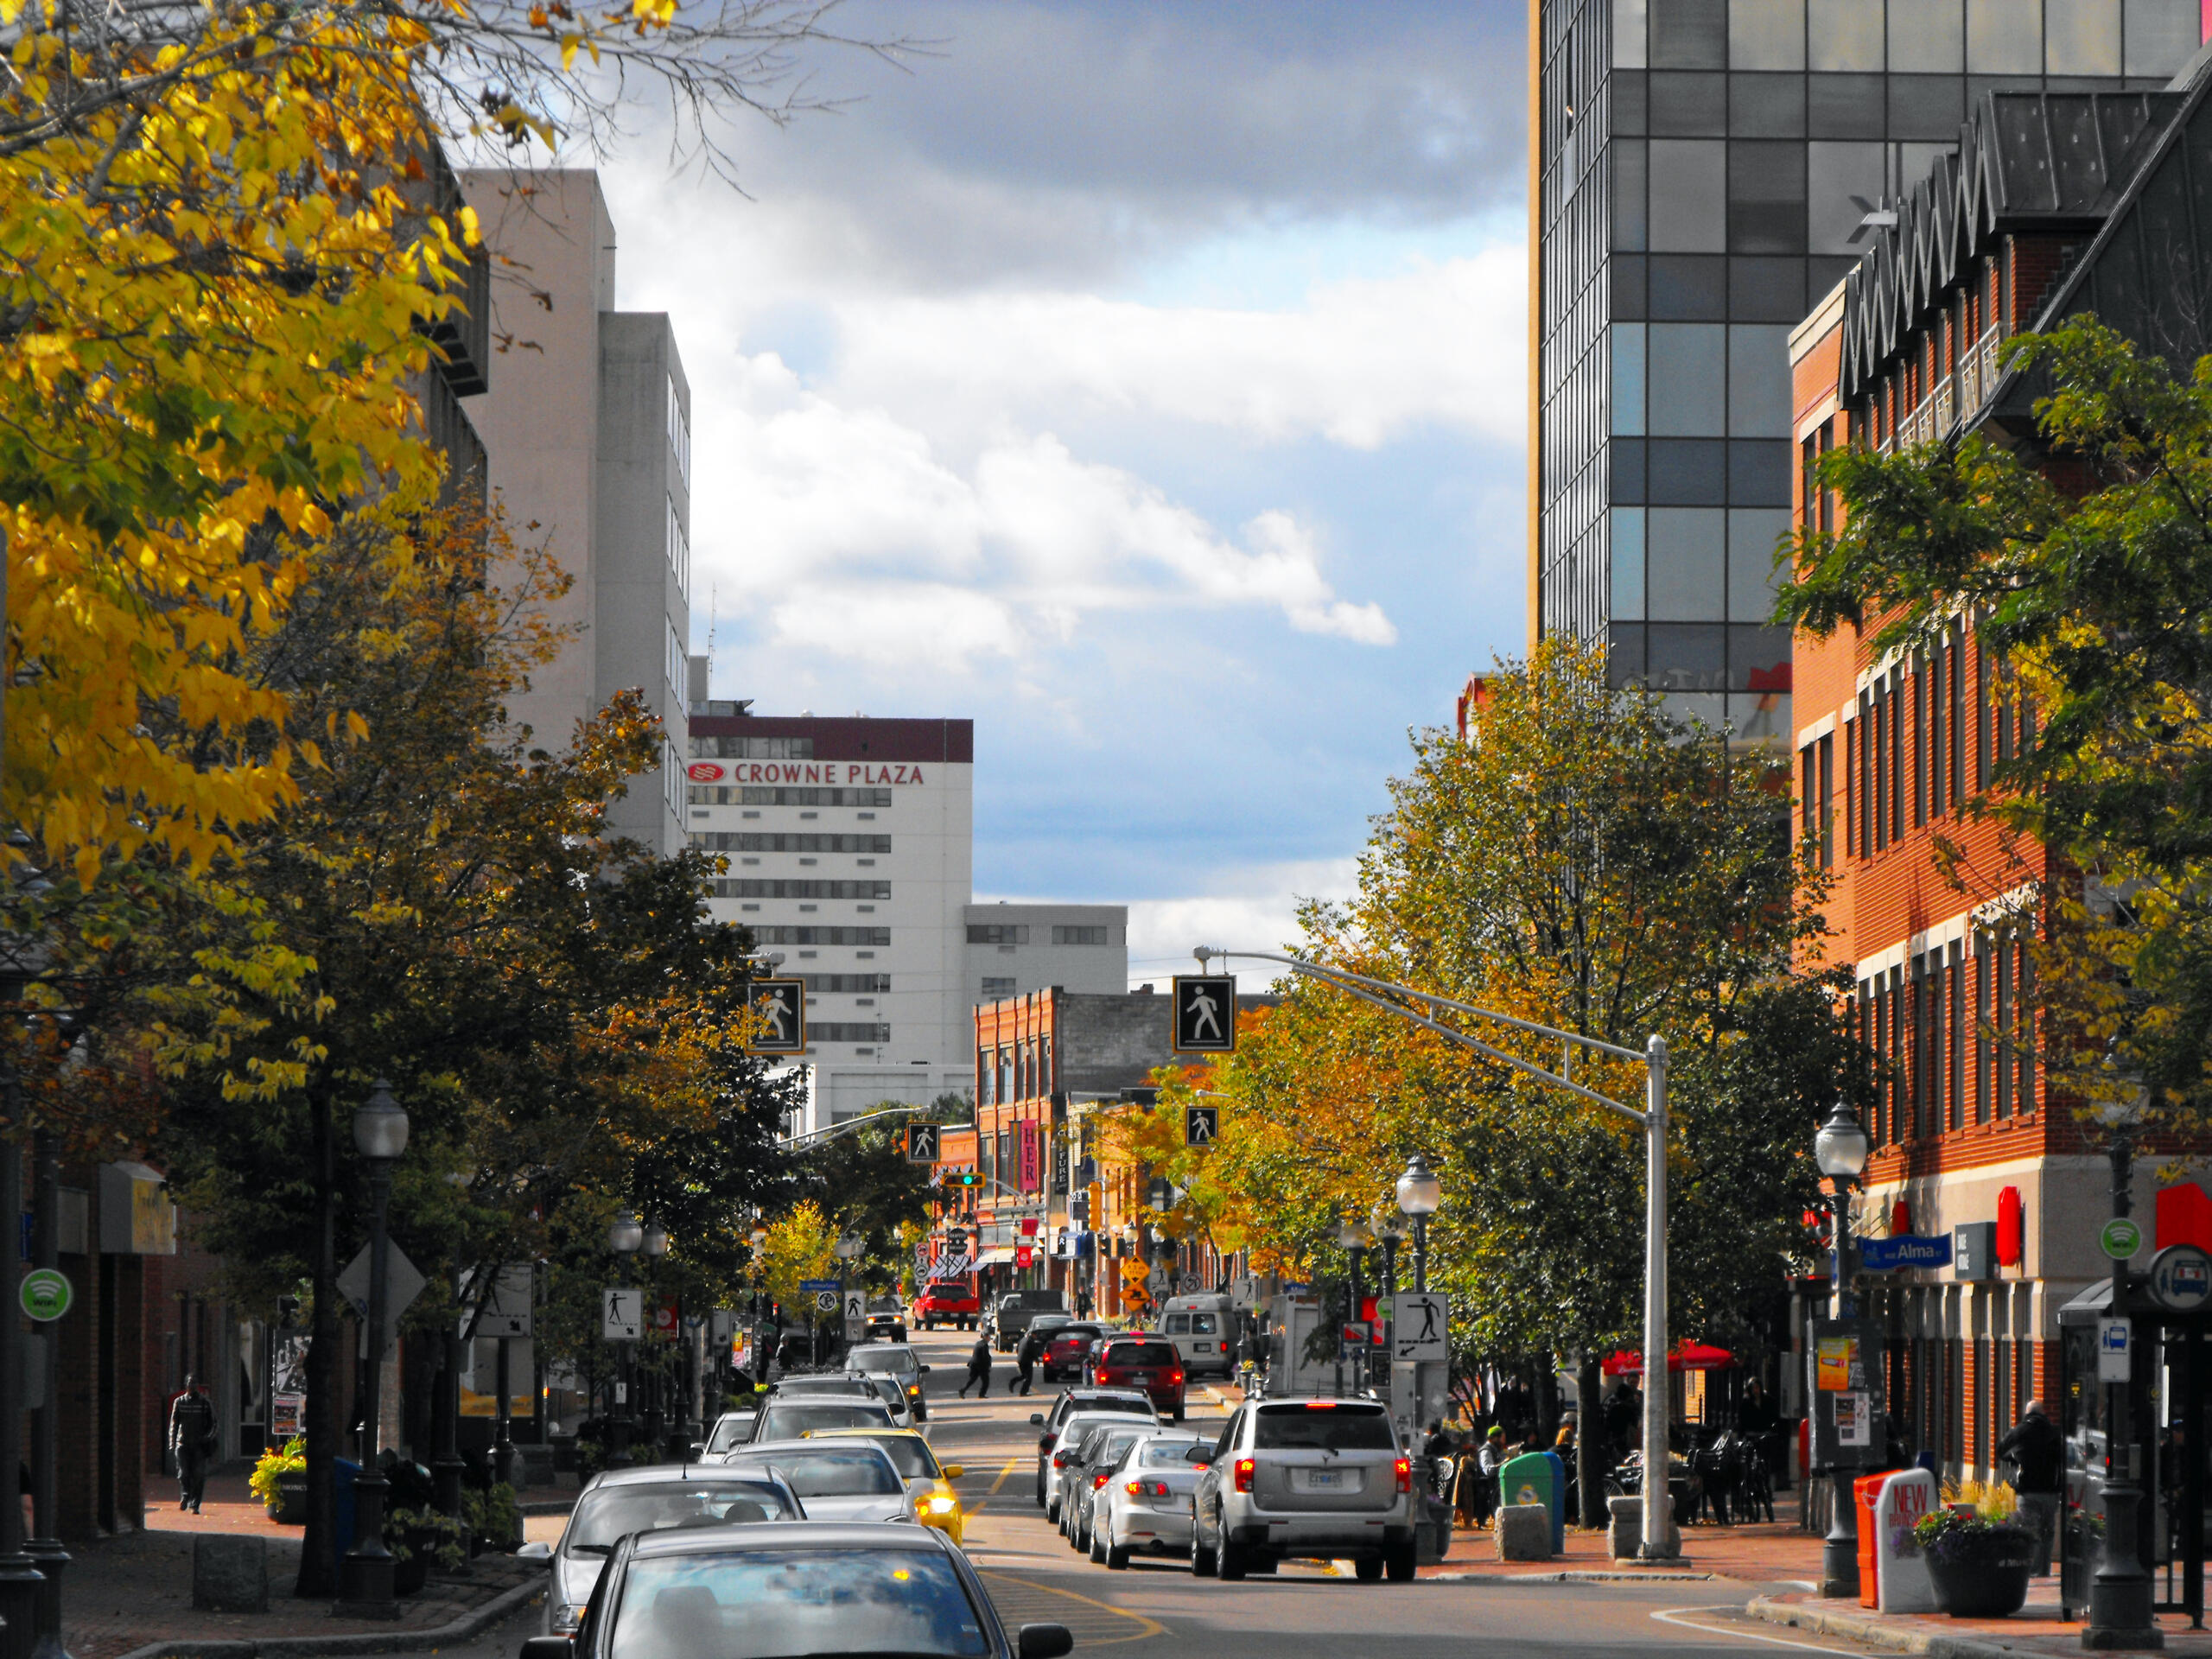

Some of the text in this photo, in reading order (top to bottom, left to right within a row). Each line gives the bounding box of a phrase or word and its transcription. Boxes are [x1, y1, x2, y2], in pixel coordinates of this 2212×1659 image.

[734, 763, 925, 785] CROWNE PLAZA
[1025, 1128, 1034, 1181] HER
[1897, 1243, 1935, 1260] Alma
[1893, 1484, 1929, 1514] NEW
